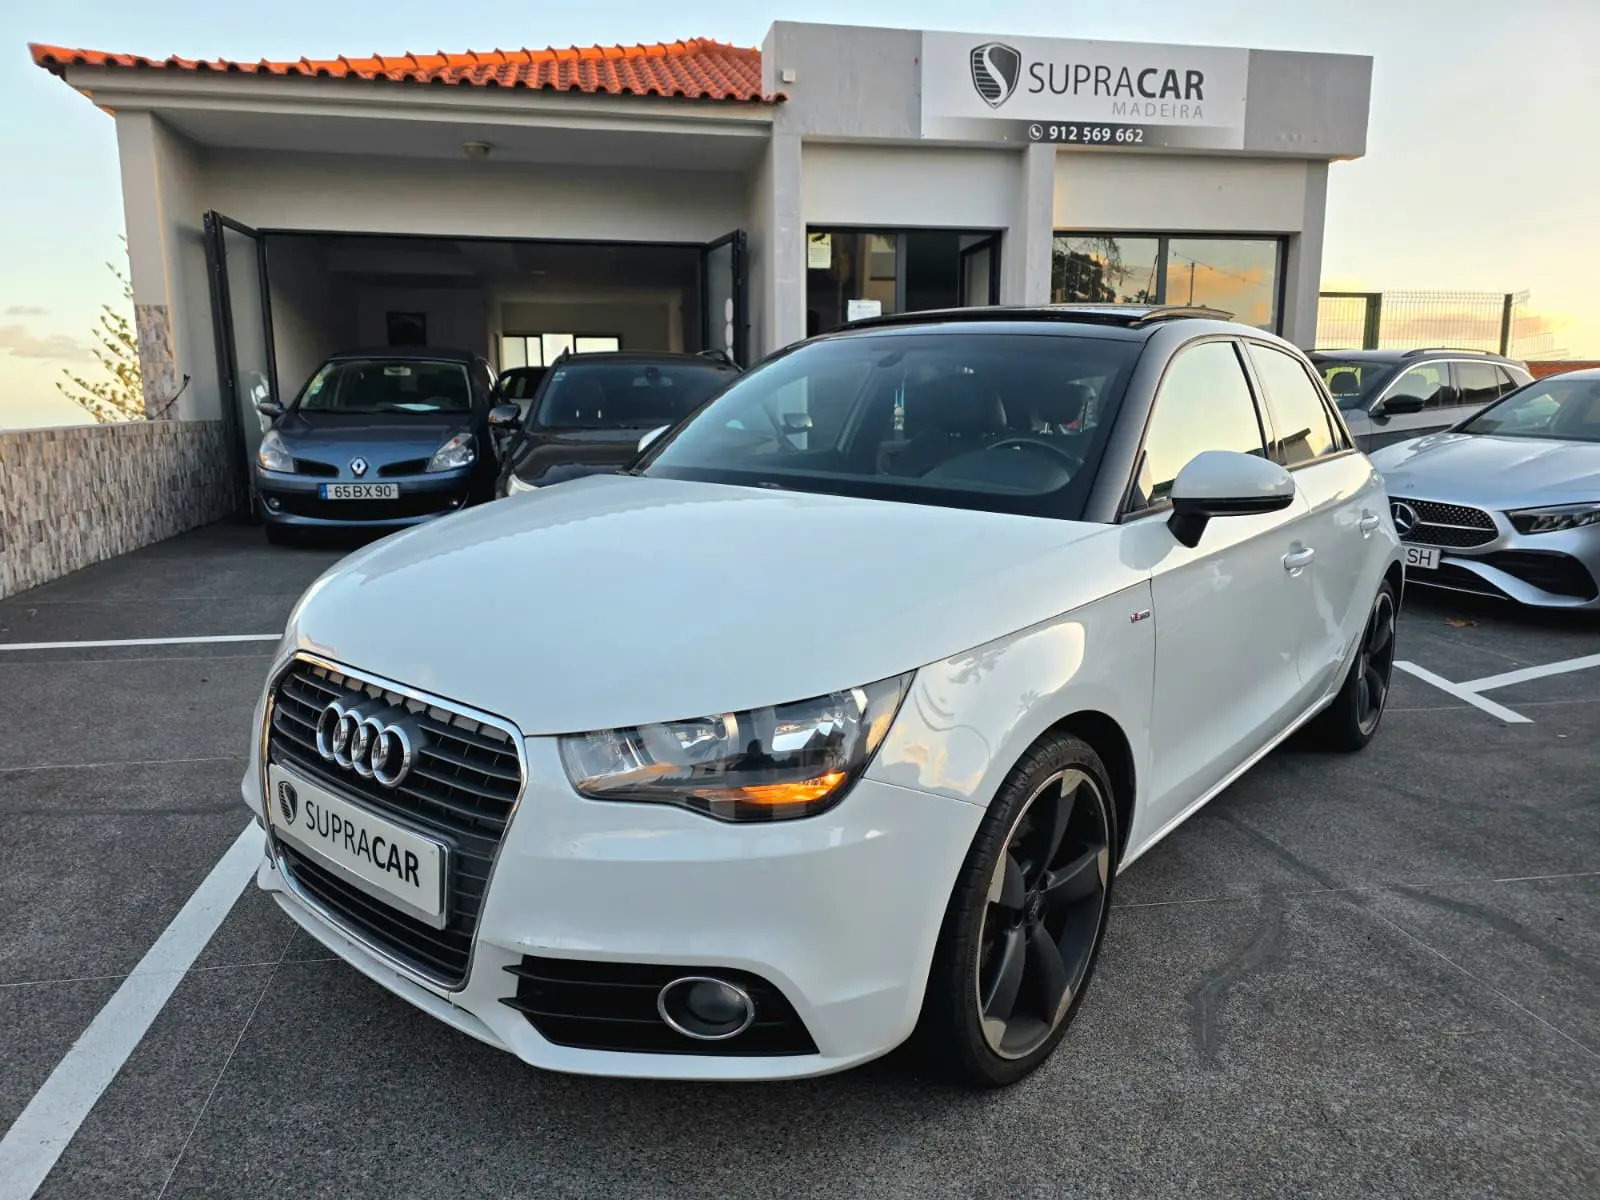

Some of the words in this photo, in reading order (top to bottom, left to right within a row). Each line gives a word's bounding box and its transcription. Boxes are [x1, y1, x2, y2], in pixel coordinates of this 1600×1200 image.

[1028, 62, 1205, 101] SUPRACAR
[1112, 101, 1204, 119] MADEIRA
[1049, 125, 1077, 140] 912
[1083, 127, 1111, 141] 569
[1115, 128, 1144, 143] 662
[305, 799, 420, 888] SUPRACAR
